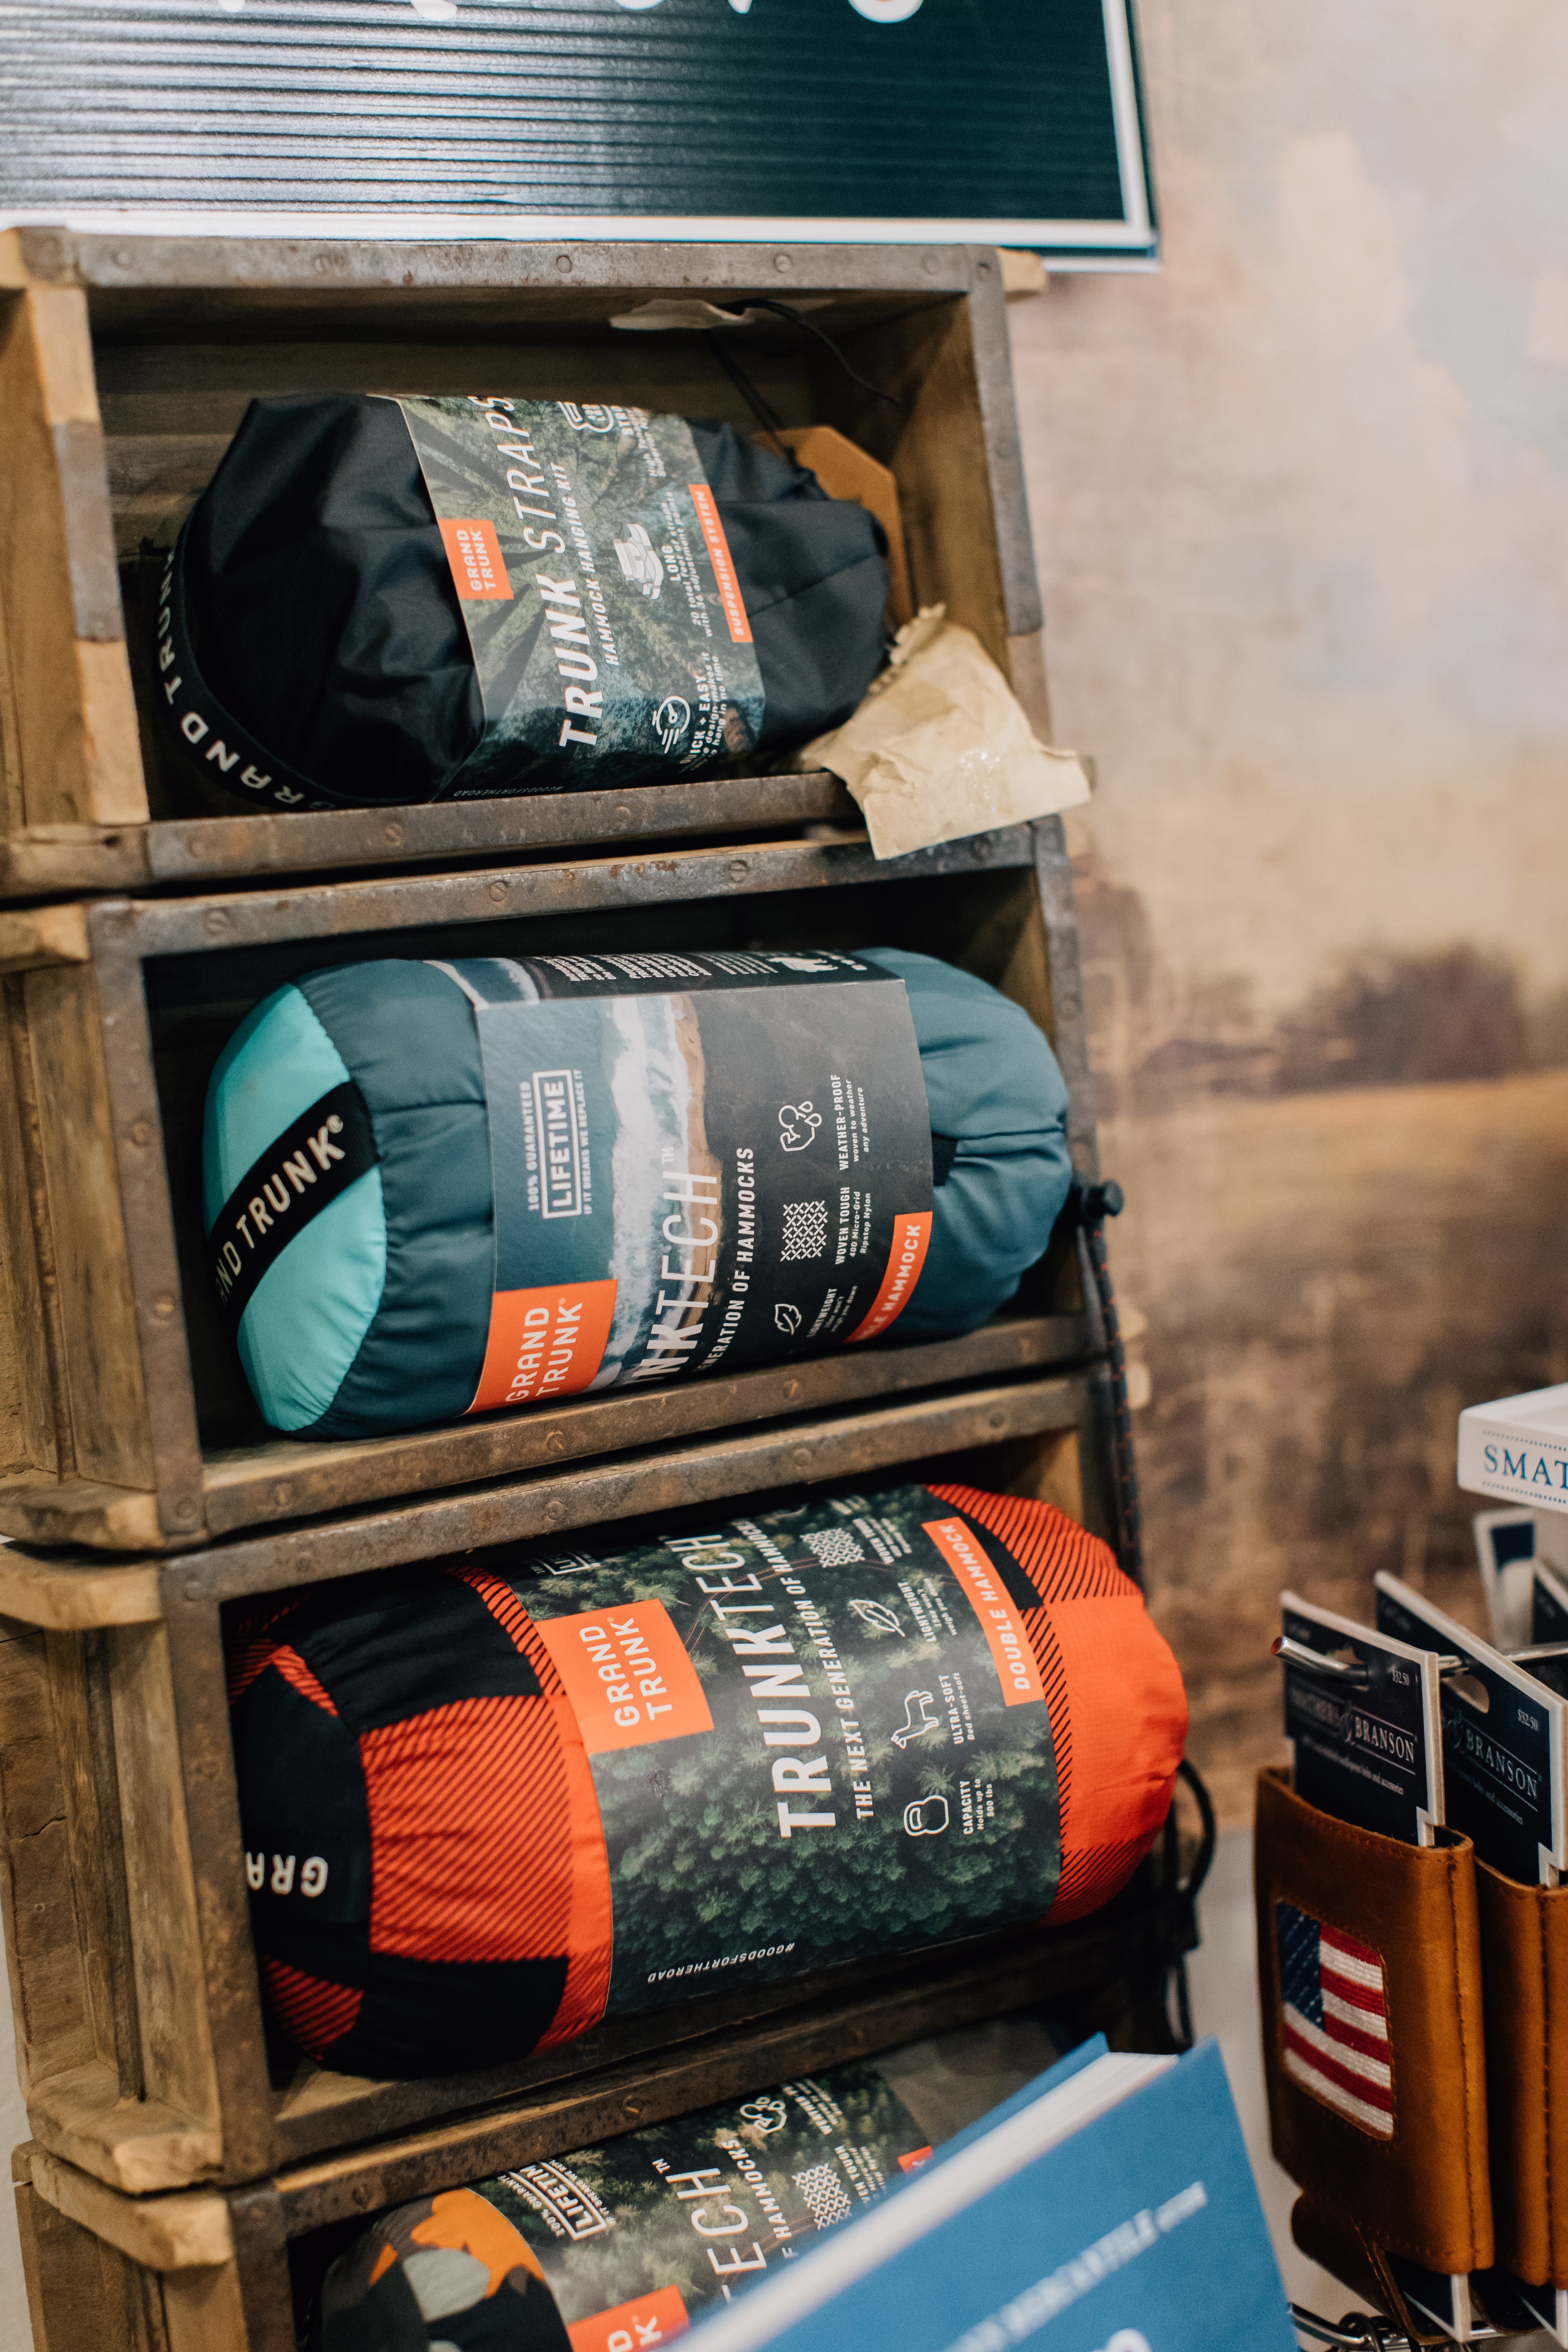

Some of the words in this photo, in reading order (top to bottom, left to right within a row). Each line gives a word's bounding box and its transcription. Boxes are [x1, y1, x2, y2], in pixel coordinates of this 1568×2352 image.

[550, 462, 571, 491] KIT
[661, 502, 678, 537] straps
[666, 491, 685, 526] points
[695, 491, 720, 544] SYSTEM
[562, 496, 595, 573] HANGING
[671, 539, 682, 552] of
[456, 529, 483, 591] GRAND
[662, 545, 682, 582] LONG
[676, 554, 689, 578] feet
[677, 527, 701, 592] adjustment
[683, 581, 697, 609] total
[712, 548, 744, 636] SUSPENSION
[585, 578, 619, 666] HAMMOCK
[690, 611, 701, 626] 20
[700, 612, 713, 637] with
[536, 573, 603, 747] TRUNK
[701, 652, 710, 662] it
[711, 655, 723, 682] time
[694, 675, 710, 711] EASY
[705, 665, 719, 702] makes
[719, 685, 728, 700] no
[704, 706, 720, 744] design
[718, 703, 727, 715] in
[712, 718, 727, 746] hang
[573, 1069, 583, 1080] IT
[574, 1081, 588, 1128] REPLACE
[845, 1079, 855, 1117] weather
[857, 1087, 868, 1133] adventure
[519, 1081, 537, 1171] GUARANTEED
[579, 1130, 589, 1147] WE
[830, 1074, 849, 1171] WEATHER-PROOF
[850, 1120, 857, 1130] to
[543, 1080, 573, 1207] LIFETIME
[581, 1148, 591, 1190] BREAKS
[526, 1174, 539, 1211] 100%
[582, 1191, 592, 1202] IT
[583, 1203, 592, 1215] IF
[735, 1147, 755, 1263] HAMMOCKS
[839, 1186, 850, 1224] TOUGH
[864, 1193, 872, 1219] Nylon
[851, 1191, 861, 1239] Micro-Grid
[835, 1227, 849, 1265] WOVEN
[849, 1241, 858, 1258] 40D
[860, 1221, 871, 1254] Ripstop
[732, 1270, 750, 1292] OF
[881, 1225, 921, 1311] HAMMOCK
[505, 1307, 550, 1402] GRAND
[938, 1524, 999, 1602] HAMMOCK
[780, 1577, 806, 1595] OF
[897, 1581, 937, 1642] LIGHTWEIGHT
[934, 1598, 948, 1611] you
[941, 1612, 957, 1636] weigh
[793, 1600, 854, 1709] GENERATION
[989, 1608, 1031, 1690] DOUBLE
[579, 1626, 640, 1727] GRAND
[1392, 1669, 1410, 1687] $32.50
[938, 1674, 964, 1745] ULTRA-SOFT
[953, 1672, 971, 1721] sheet-soft
[965, 1722, 975, 1741] Bed
[1517, 1708, 1539, 1732] $32.50
[840, 1718, 868, 1772] NEXT
[1354, 1715, 1415, 1763] BRANSON
[1466, 1728, 1538, 1800] BRANSON
[853, 1780, 874, 1819] THE
[974, 1778, 981, 1788] to
[976, 1790, 984, 1803] up
[985, 1783, 993, 1798] lbs
[959, 1780, 974, 1835] CAPACITY
[976, 1804, 984, 1831] Holds
[986, 1800, 995, 1818] 500
[245, 1851, 329, 1898] GRA
[647, 1942, 795, 1984] #GOODSFORTHEROAD
[549, 2159, 567, 2173] REPL
[564, 2170, 578, 2182] WE
[834, 2146, 860, 2181] TOUGH
[497, 2174, 542, 2210] GUARANT
[520, 2165, 593, 2229] LIFETIM
[576, 2179, 603, 2208] BREAKS
[722, 2139, 792, 2239] HAMMOCKS
[541, 2208, 565, 2238] 100%
[599, 2207, 610, 2217] IT
